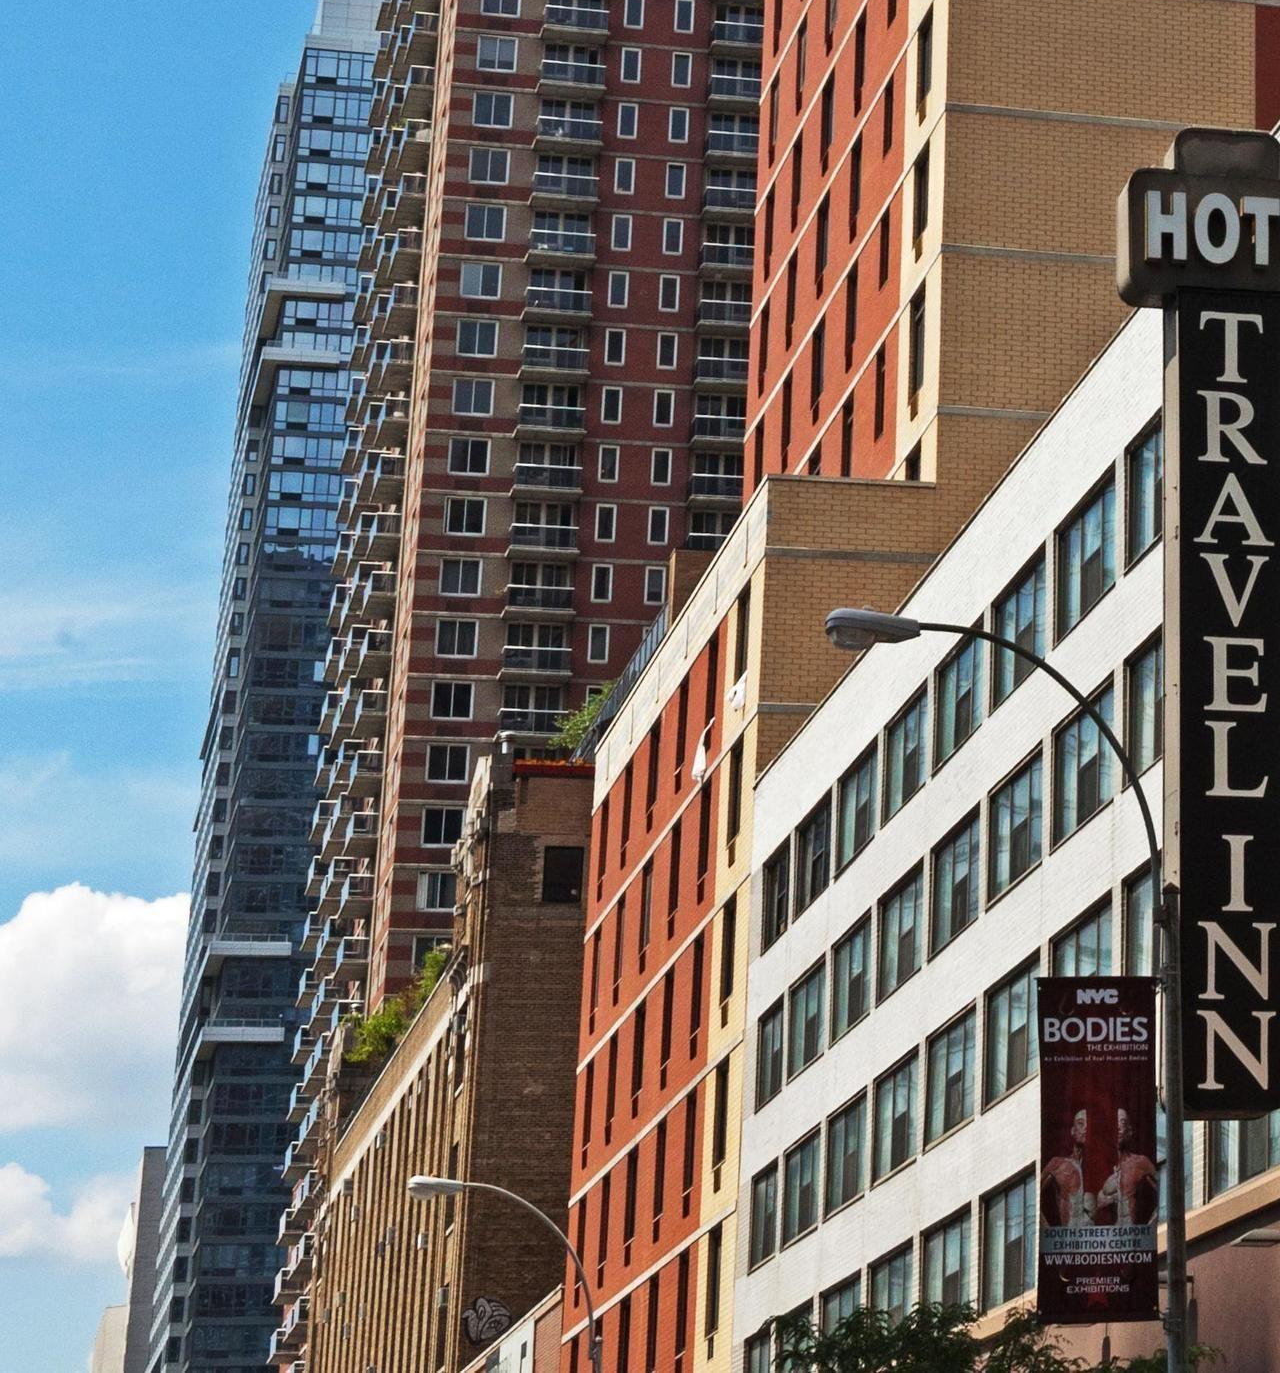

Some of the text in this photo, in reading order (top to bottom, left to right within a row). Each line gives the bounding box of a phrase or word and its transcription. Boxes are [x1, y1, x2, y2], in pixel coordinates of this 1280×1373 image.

[1193, 310, 1277, 1091] TRAVEL INN
[1076, 989, 1119, 1004] NYC
[1043, 1016, 1149, 1043] BODIES
[1087, 1043, 1149, 1052] THE EXHIBITION
[1045, 1227, 1151, 1239] SOUTH STREET SEAPORT
[1053, 1239, 1107, 1250] EXHIBITION
[1044, 1252, 1153, 1265] WWW.BODIESNY.COM
[1075, 1276, 1121, 1285] PREMIER
[1066, 1284, 1130, 1294] EXHIBITIONS
